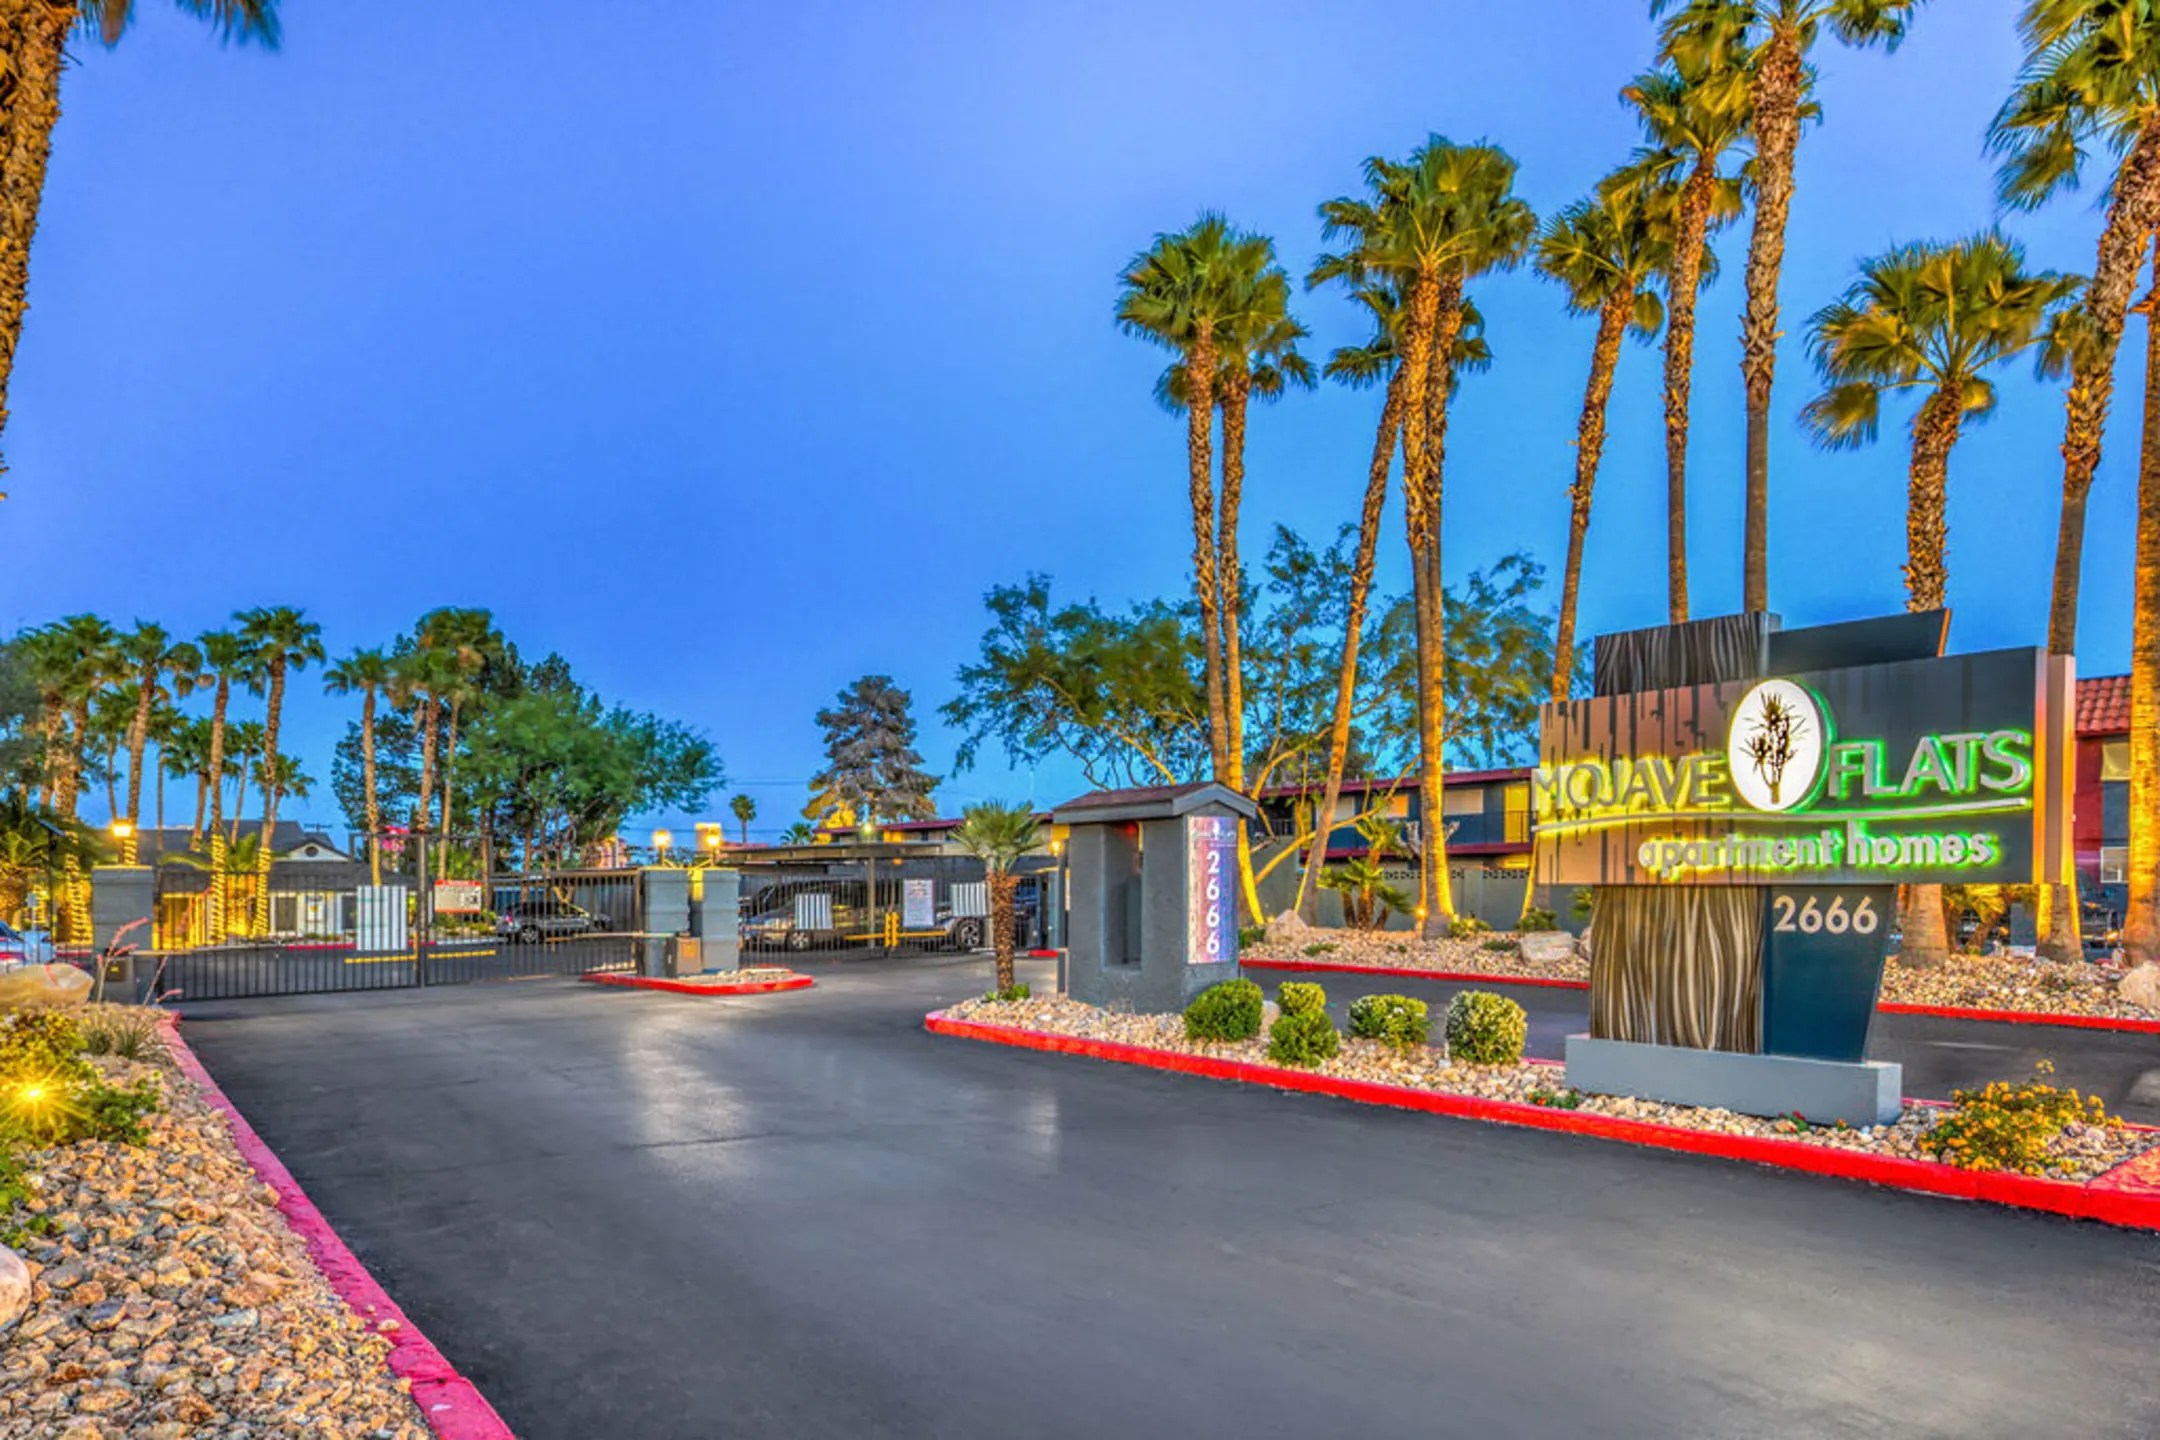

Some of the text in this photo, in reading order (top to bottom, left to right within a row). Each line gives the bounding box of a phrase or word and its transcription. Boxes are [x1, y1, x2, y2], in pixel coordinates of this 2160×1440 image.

[1531, 729, 2028, 811] MOJAVE FLATS
[1638, 819, 1996, 878] apartment homes
[1205, 849, 1221, 955] 2666
[1772, 894, 1879, 934] 2666
